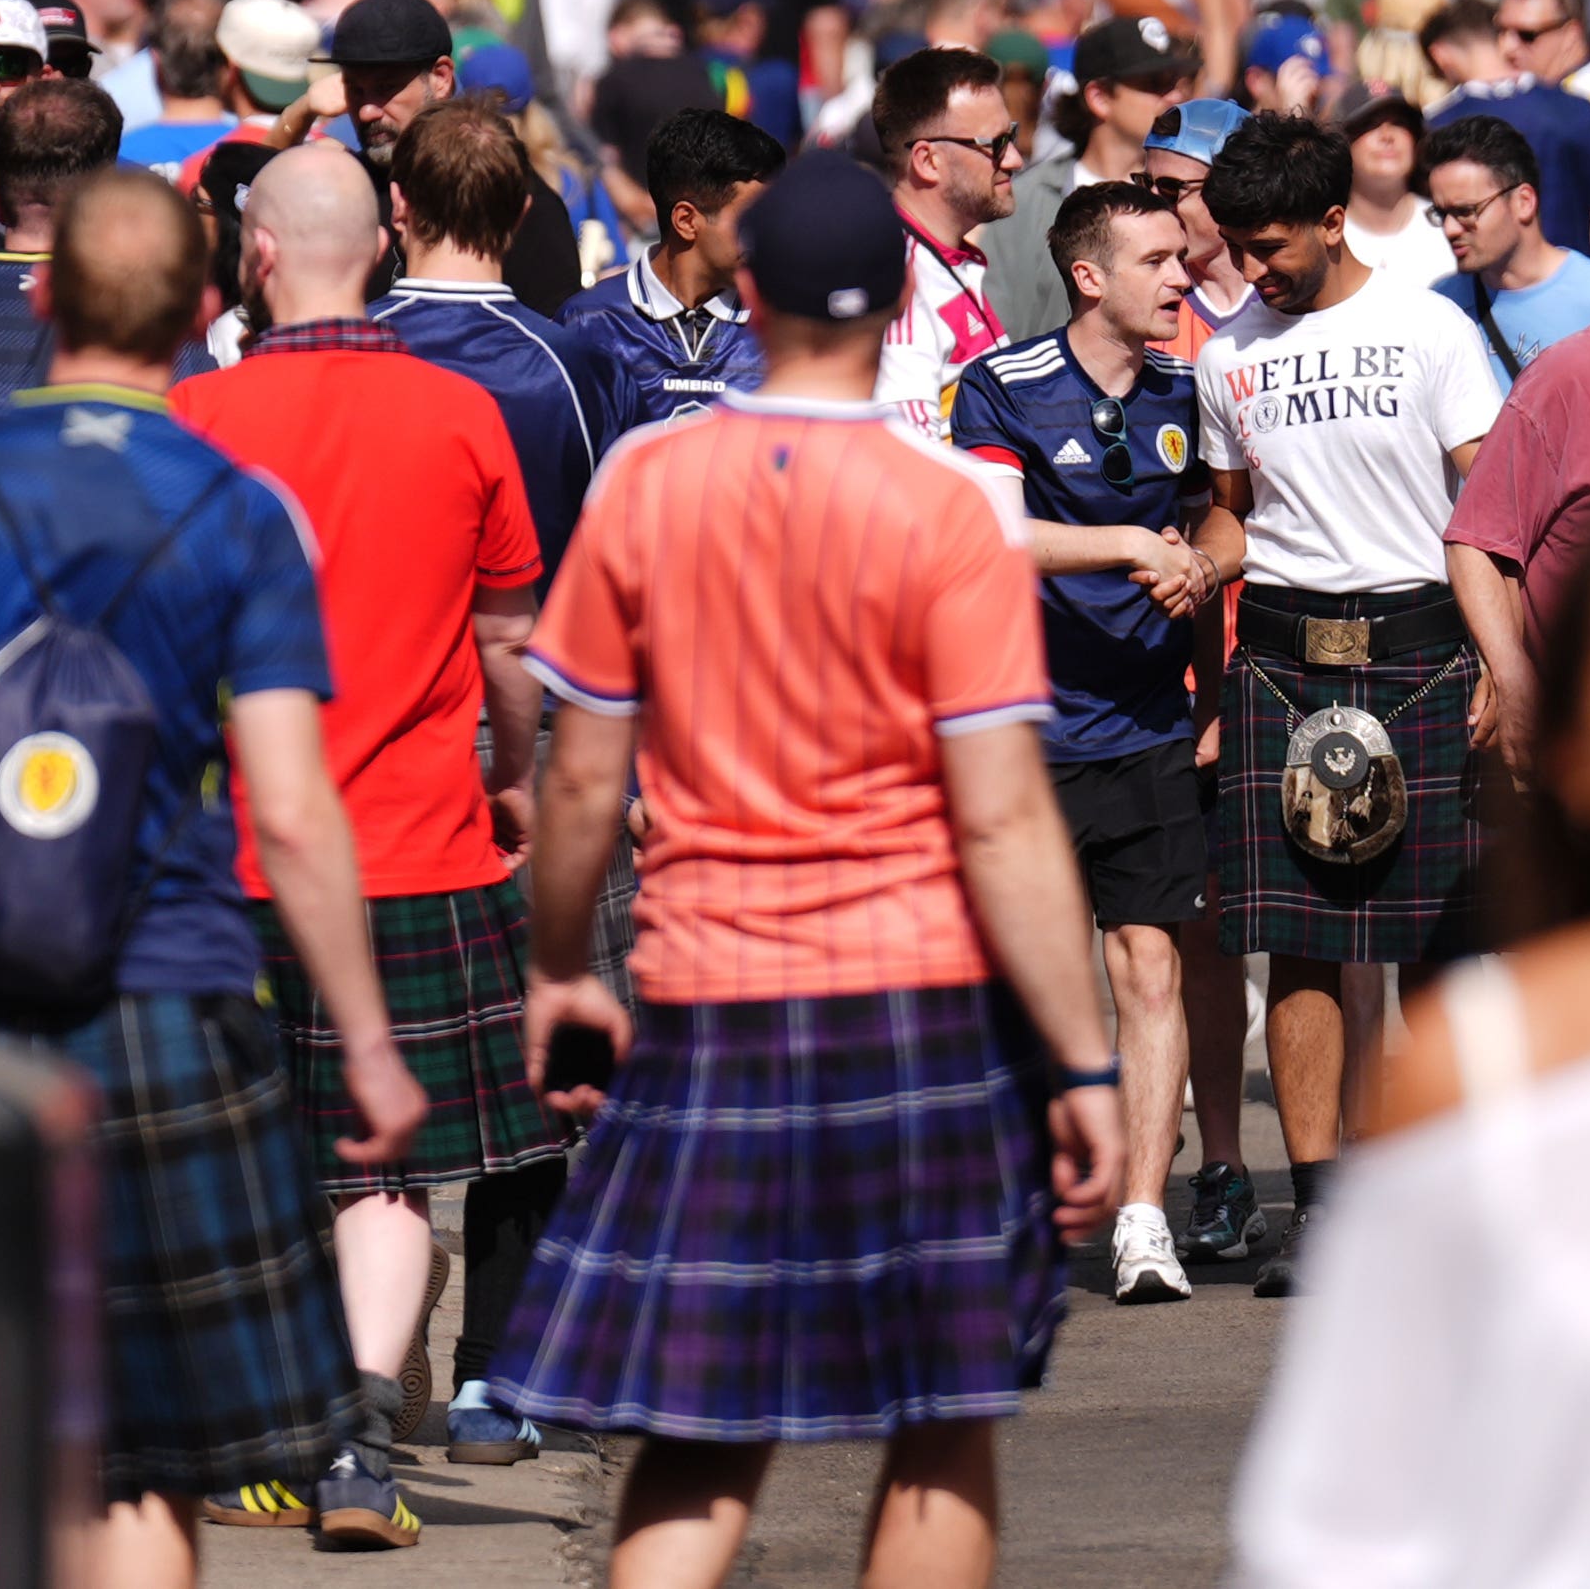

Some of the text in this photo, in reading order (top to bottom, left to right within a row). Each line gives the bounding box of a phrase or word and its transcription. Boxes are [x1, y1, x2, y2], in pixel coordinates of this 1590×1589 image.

[663, 379, 726, 393] UMBRO
[1225, 346, 1404, 403] WE'LL BE
